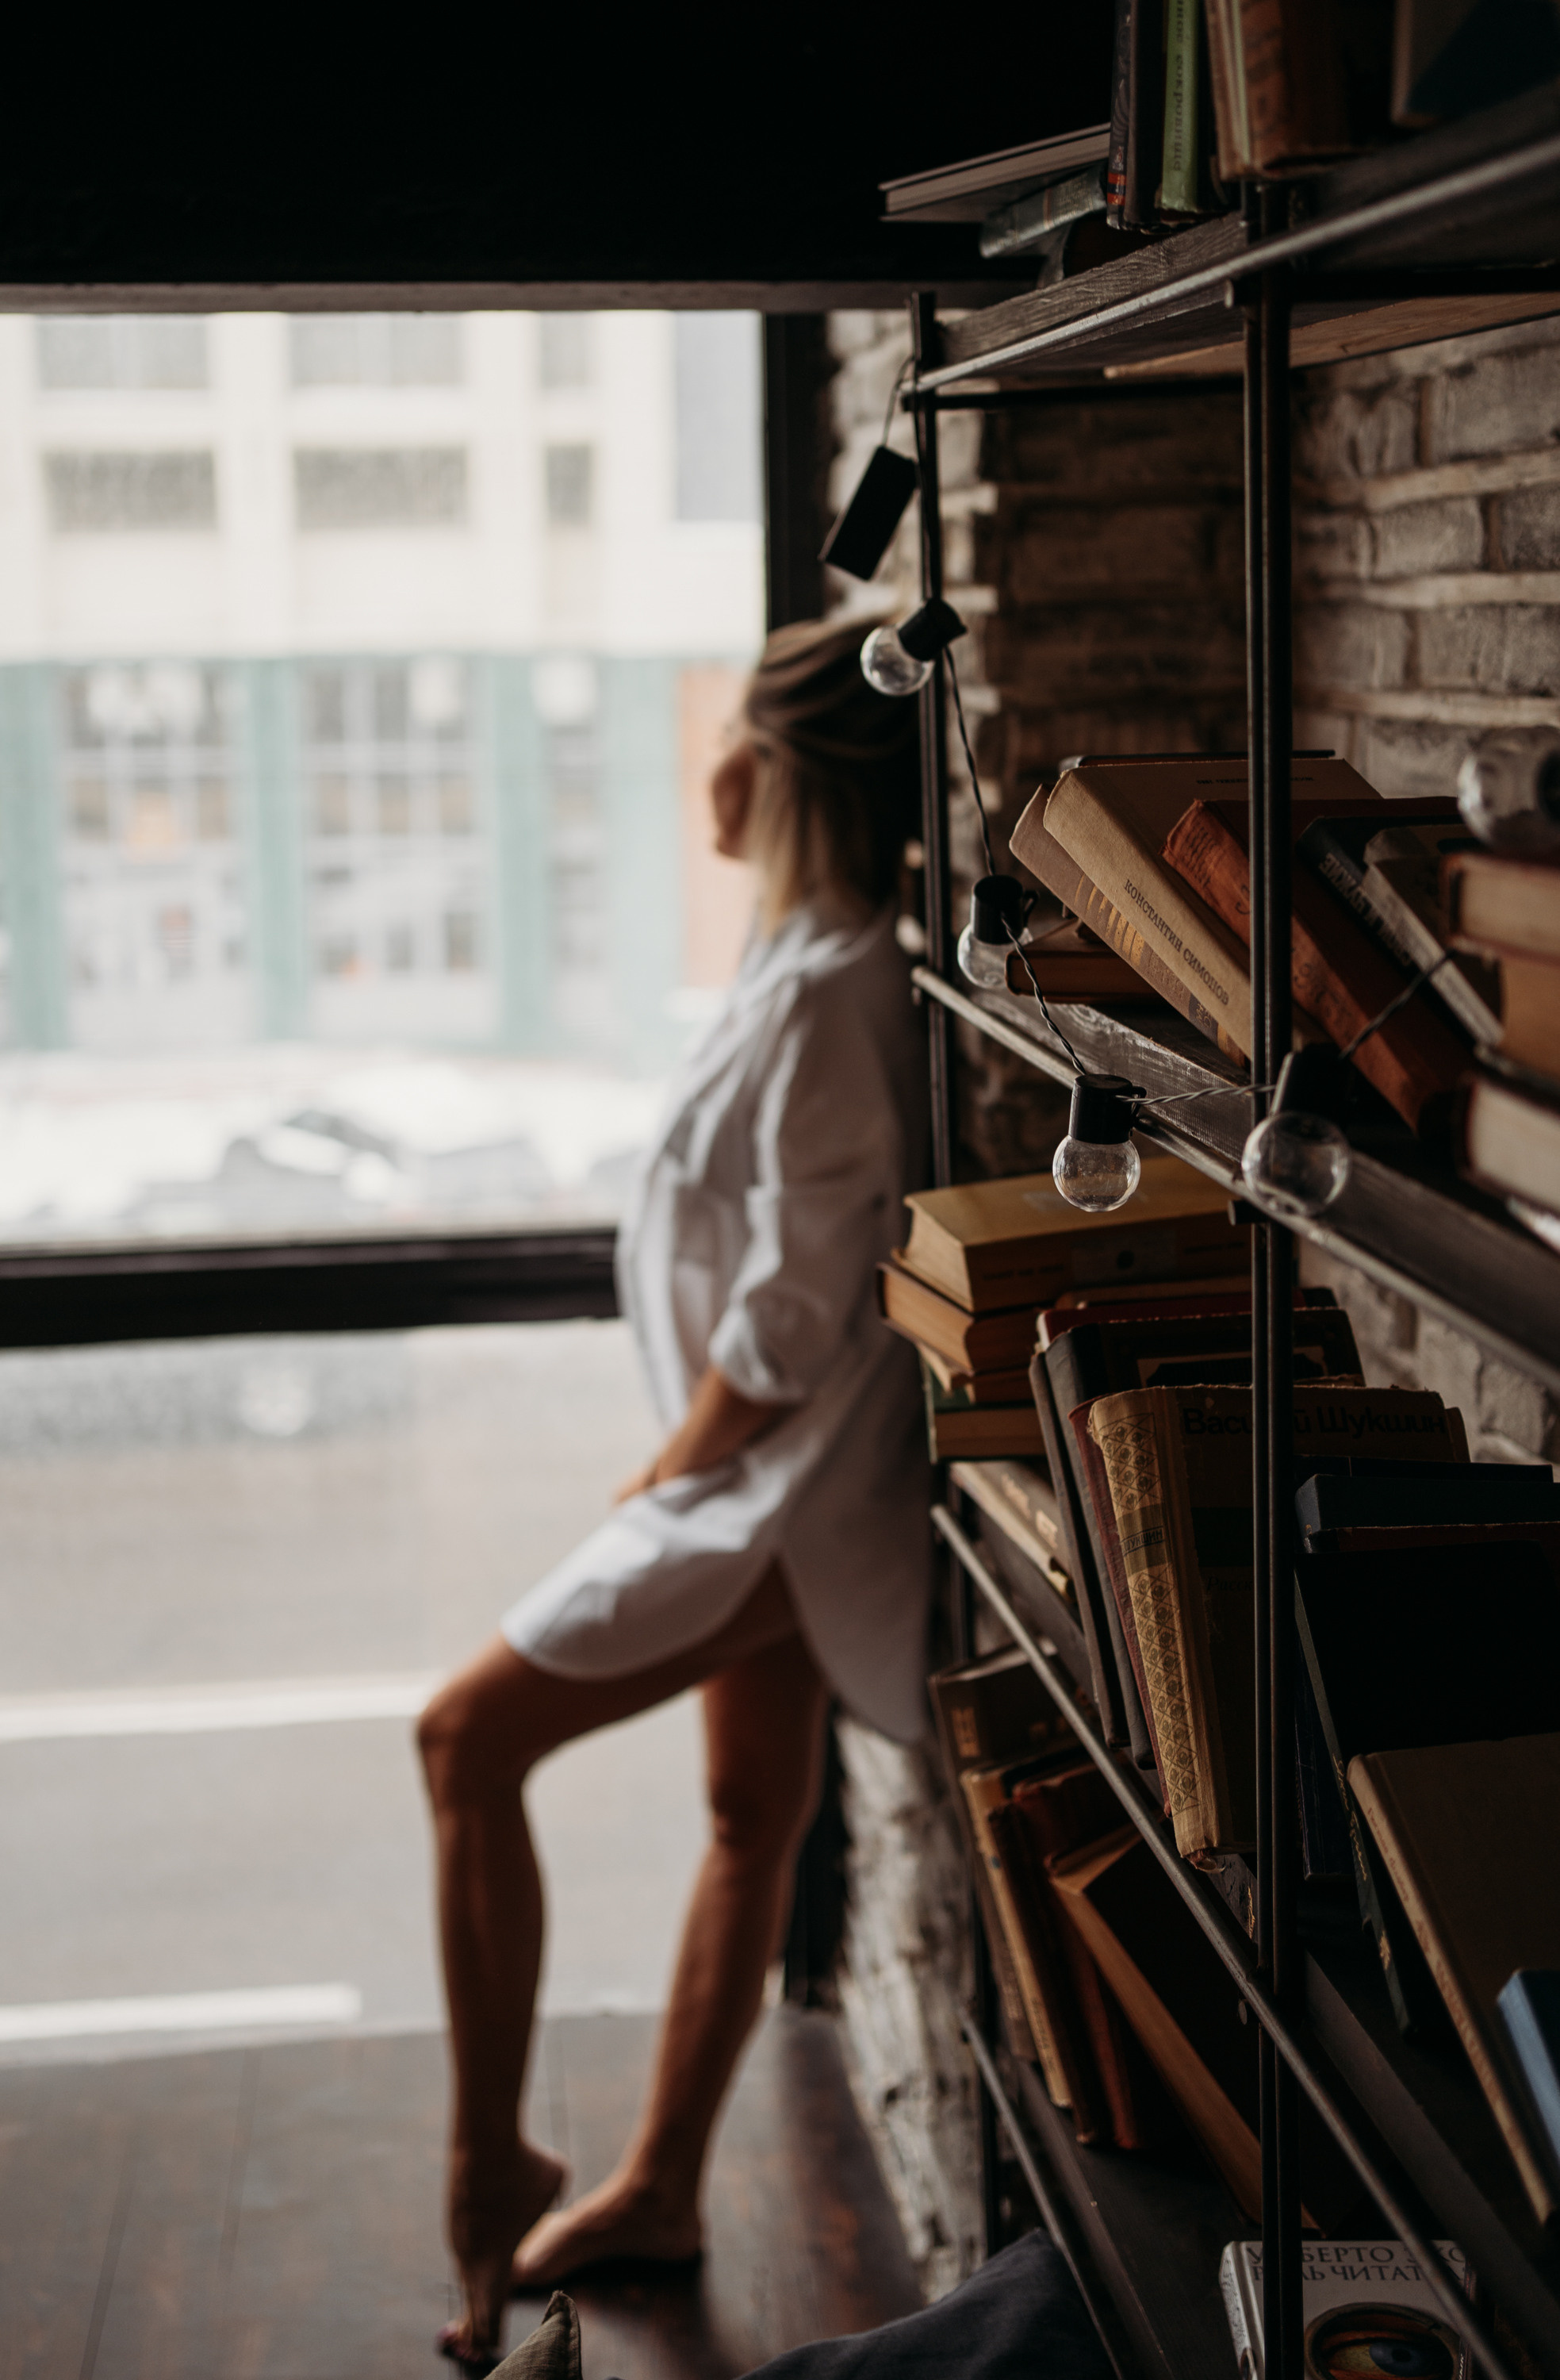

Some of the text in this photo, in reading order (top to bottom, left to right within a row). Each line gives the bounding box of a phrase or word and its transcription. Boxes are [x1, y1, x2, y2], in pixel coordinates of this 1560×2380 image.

[1124, 878, 1183, 953] КОНСТАНТИН
[1182, 947, 1229, 1006] СИМОНОВ
[1182, 1407, 1446, 1439] Васий Шукшин
[1206, 1576, 1254, 1594] Расск
[1246, 2246, 1394, 2265] УБЕРТО
[1331, 2264, 1424, 2282] ЧИТАТ
